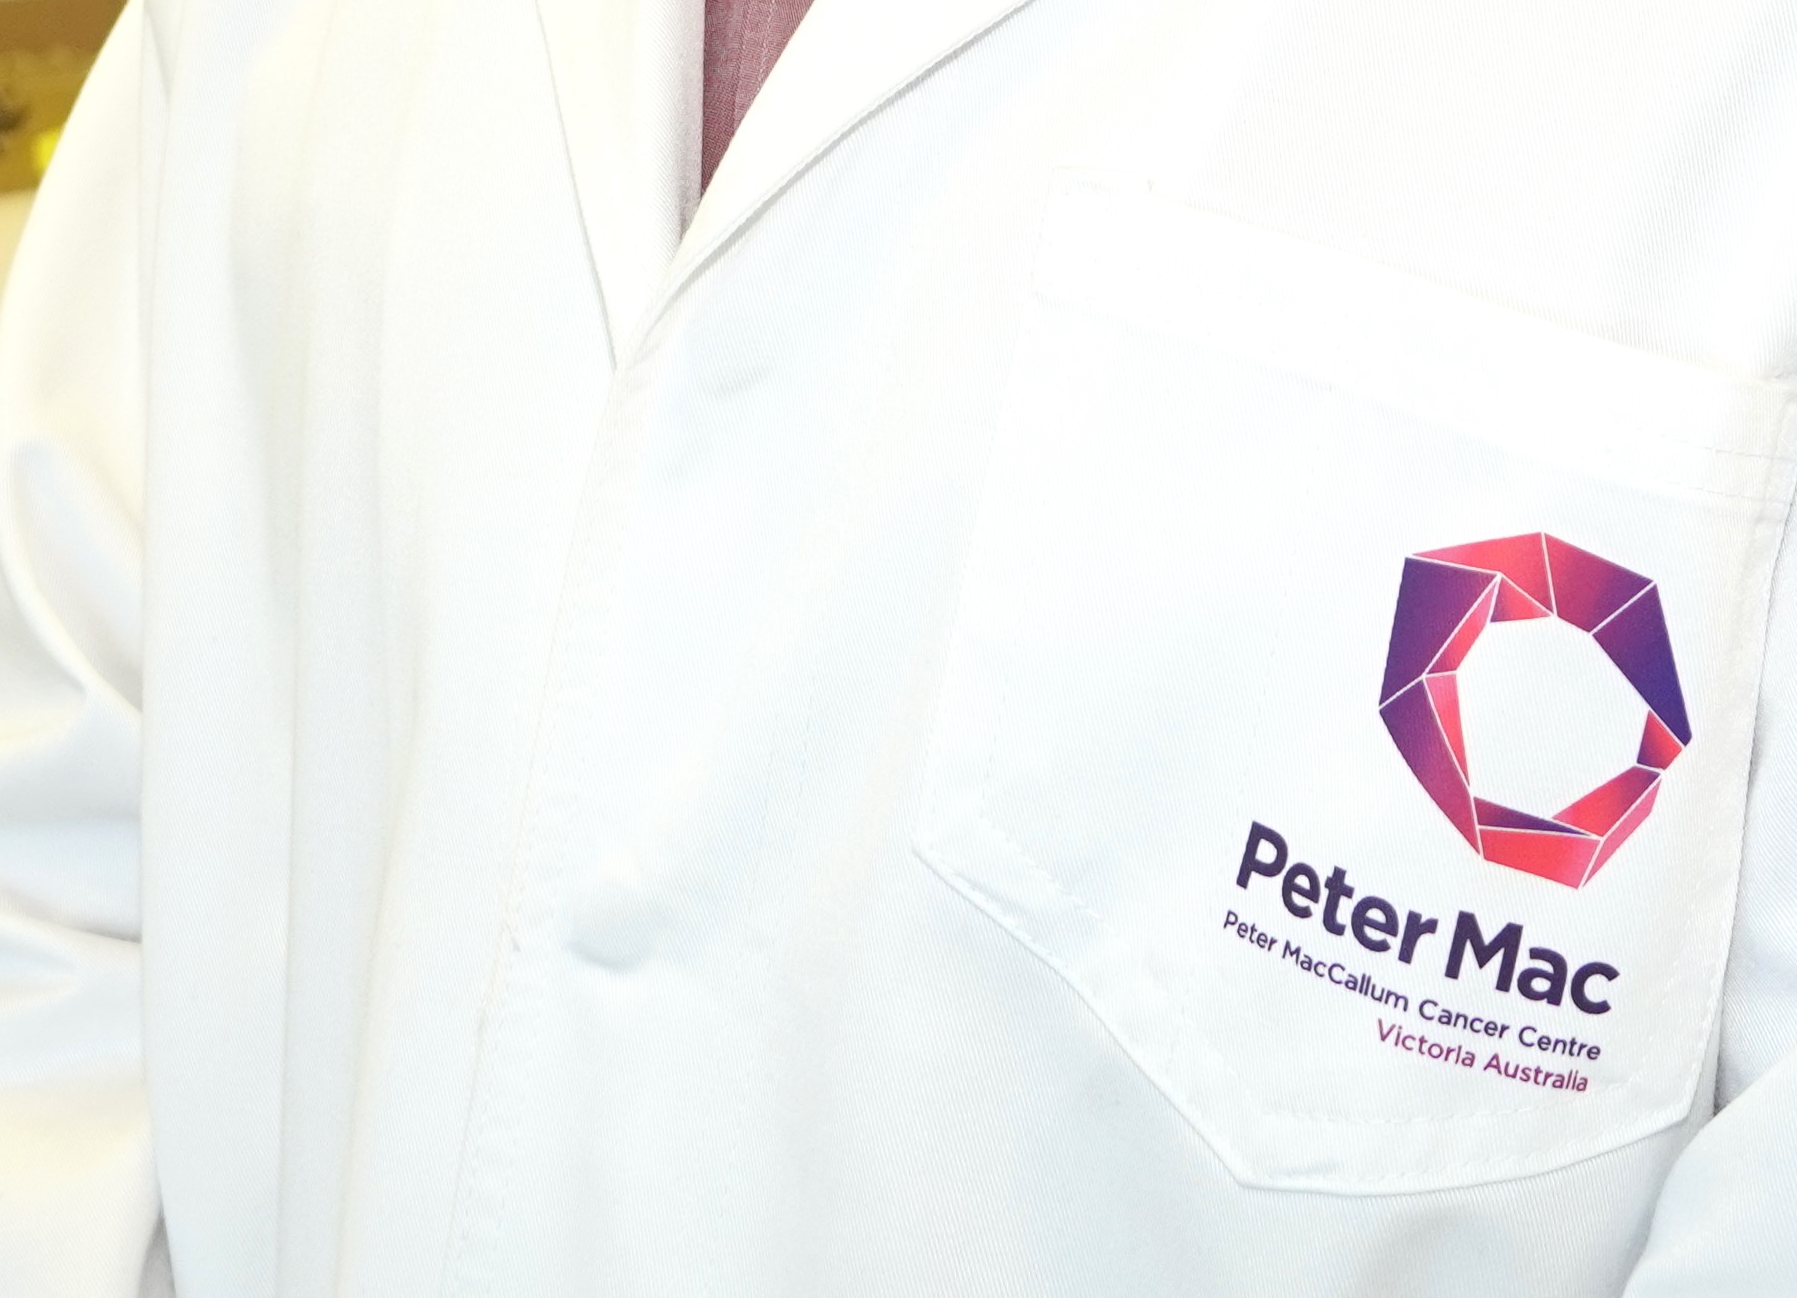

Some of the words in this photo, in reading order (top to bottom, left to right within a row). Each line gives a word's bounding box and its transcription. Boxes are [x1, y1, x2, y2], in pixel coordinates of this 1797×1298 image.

[1223, 909, 1278, 952] Peter
[1281, 940, 1409, 1013] MacCallum
[1418, 999, 1511, 1039] Cancer
[1518, 1025, 1601, 1061] Centre
[1235, 820, 1439, 965] Peter
[1444, 910, 1621, 1016] Mac
[1378, 1018, 1476, 1068] Victoria
[1483, 1053, 1589, 1092] Australia
